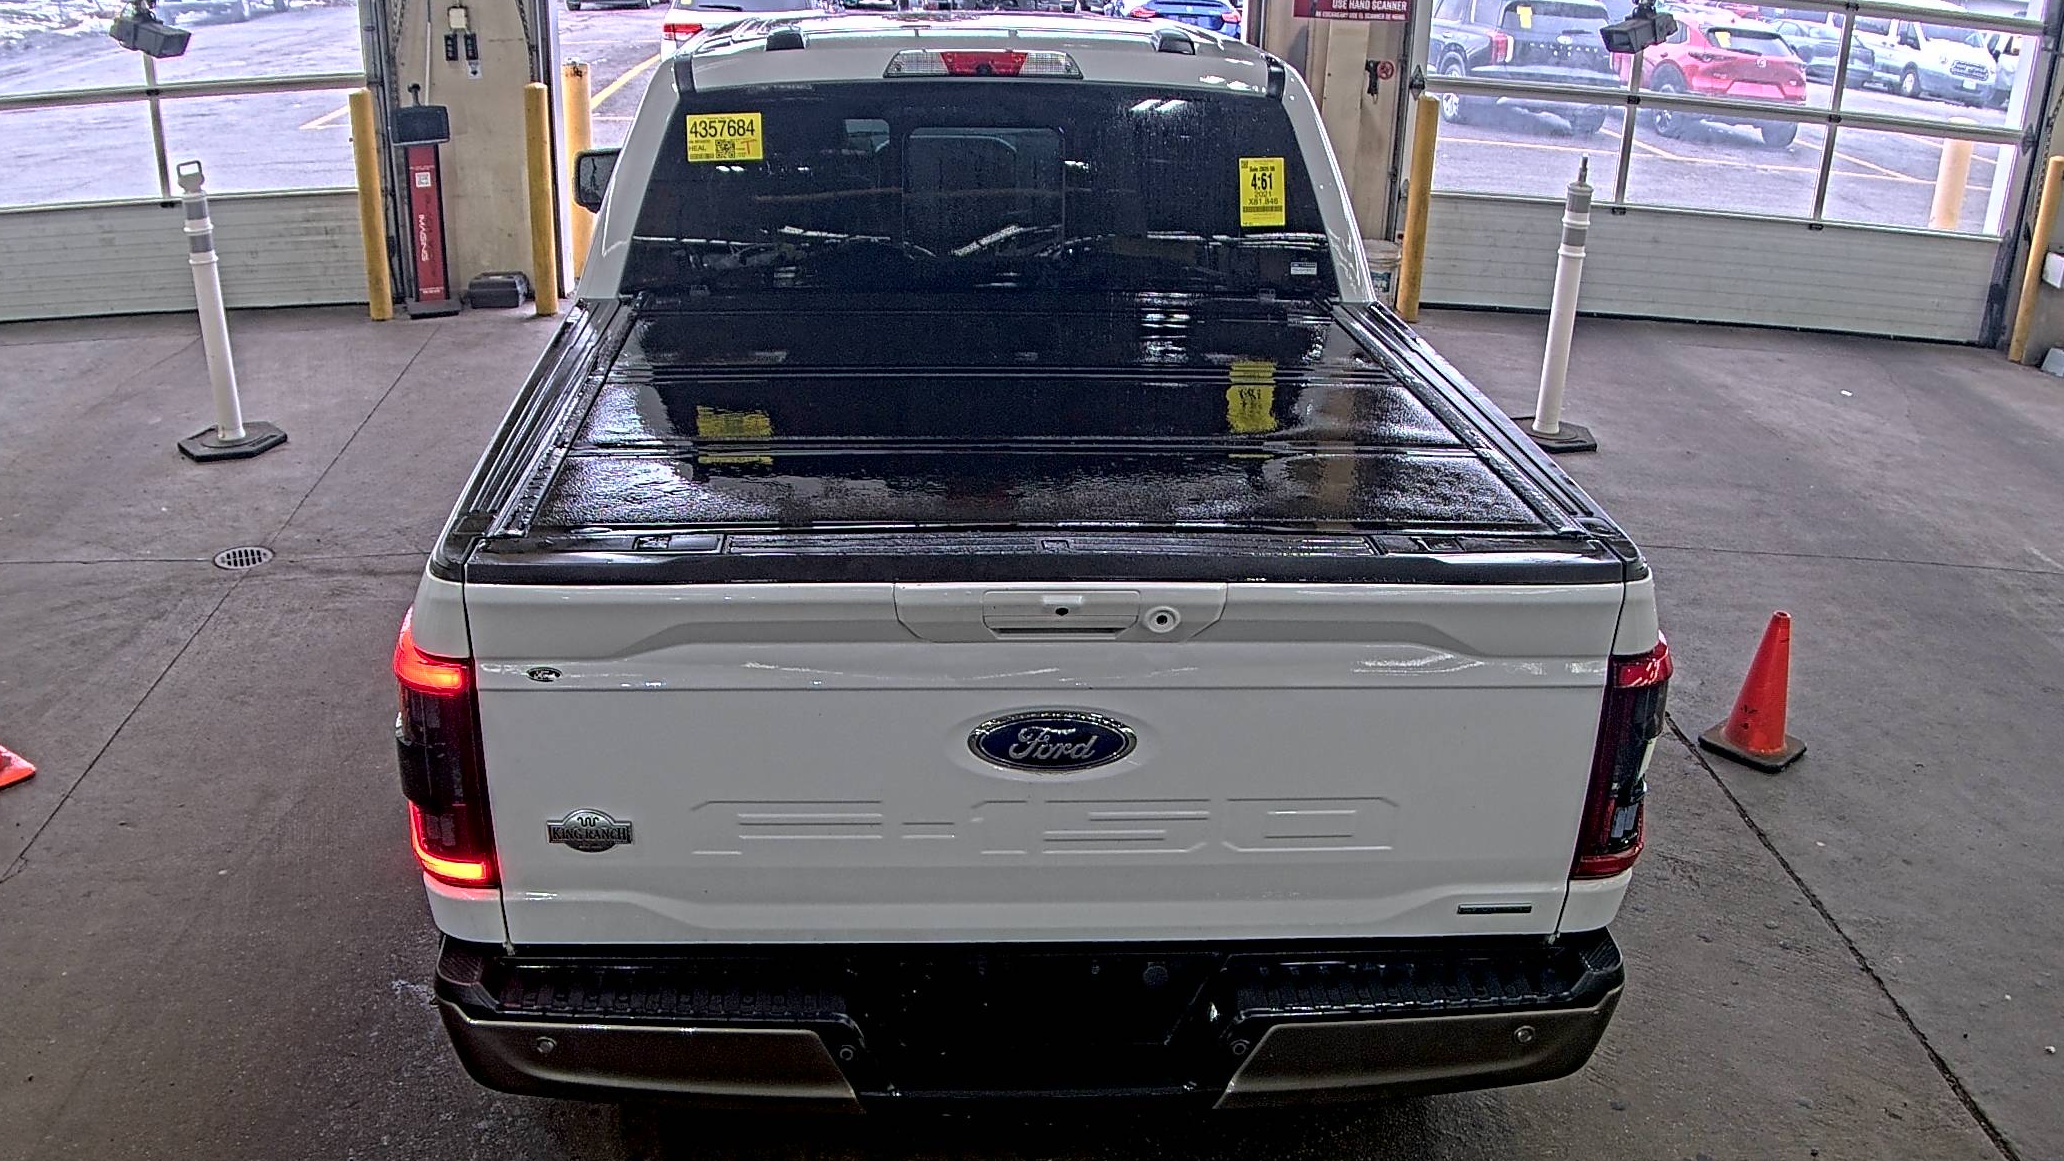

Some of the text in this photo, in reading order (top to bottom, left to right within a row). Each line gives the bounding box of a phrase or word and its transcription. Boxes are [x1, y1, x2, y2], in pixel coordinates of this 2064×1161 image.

[1332, 0, 1407, 11] USE HAND SCANNER
[690, 119, 755, 138] 4357684
[1251, 173, 1273, 190] 4:61
[418, 214, 429, 262] IMAGING
[1008, 726, 1098, 760] Ford
[552, 827, 627, 840] KING RANCH
